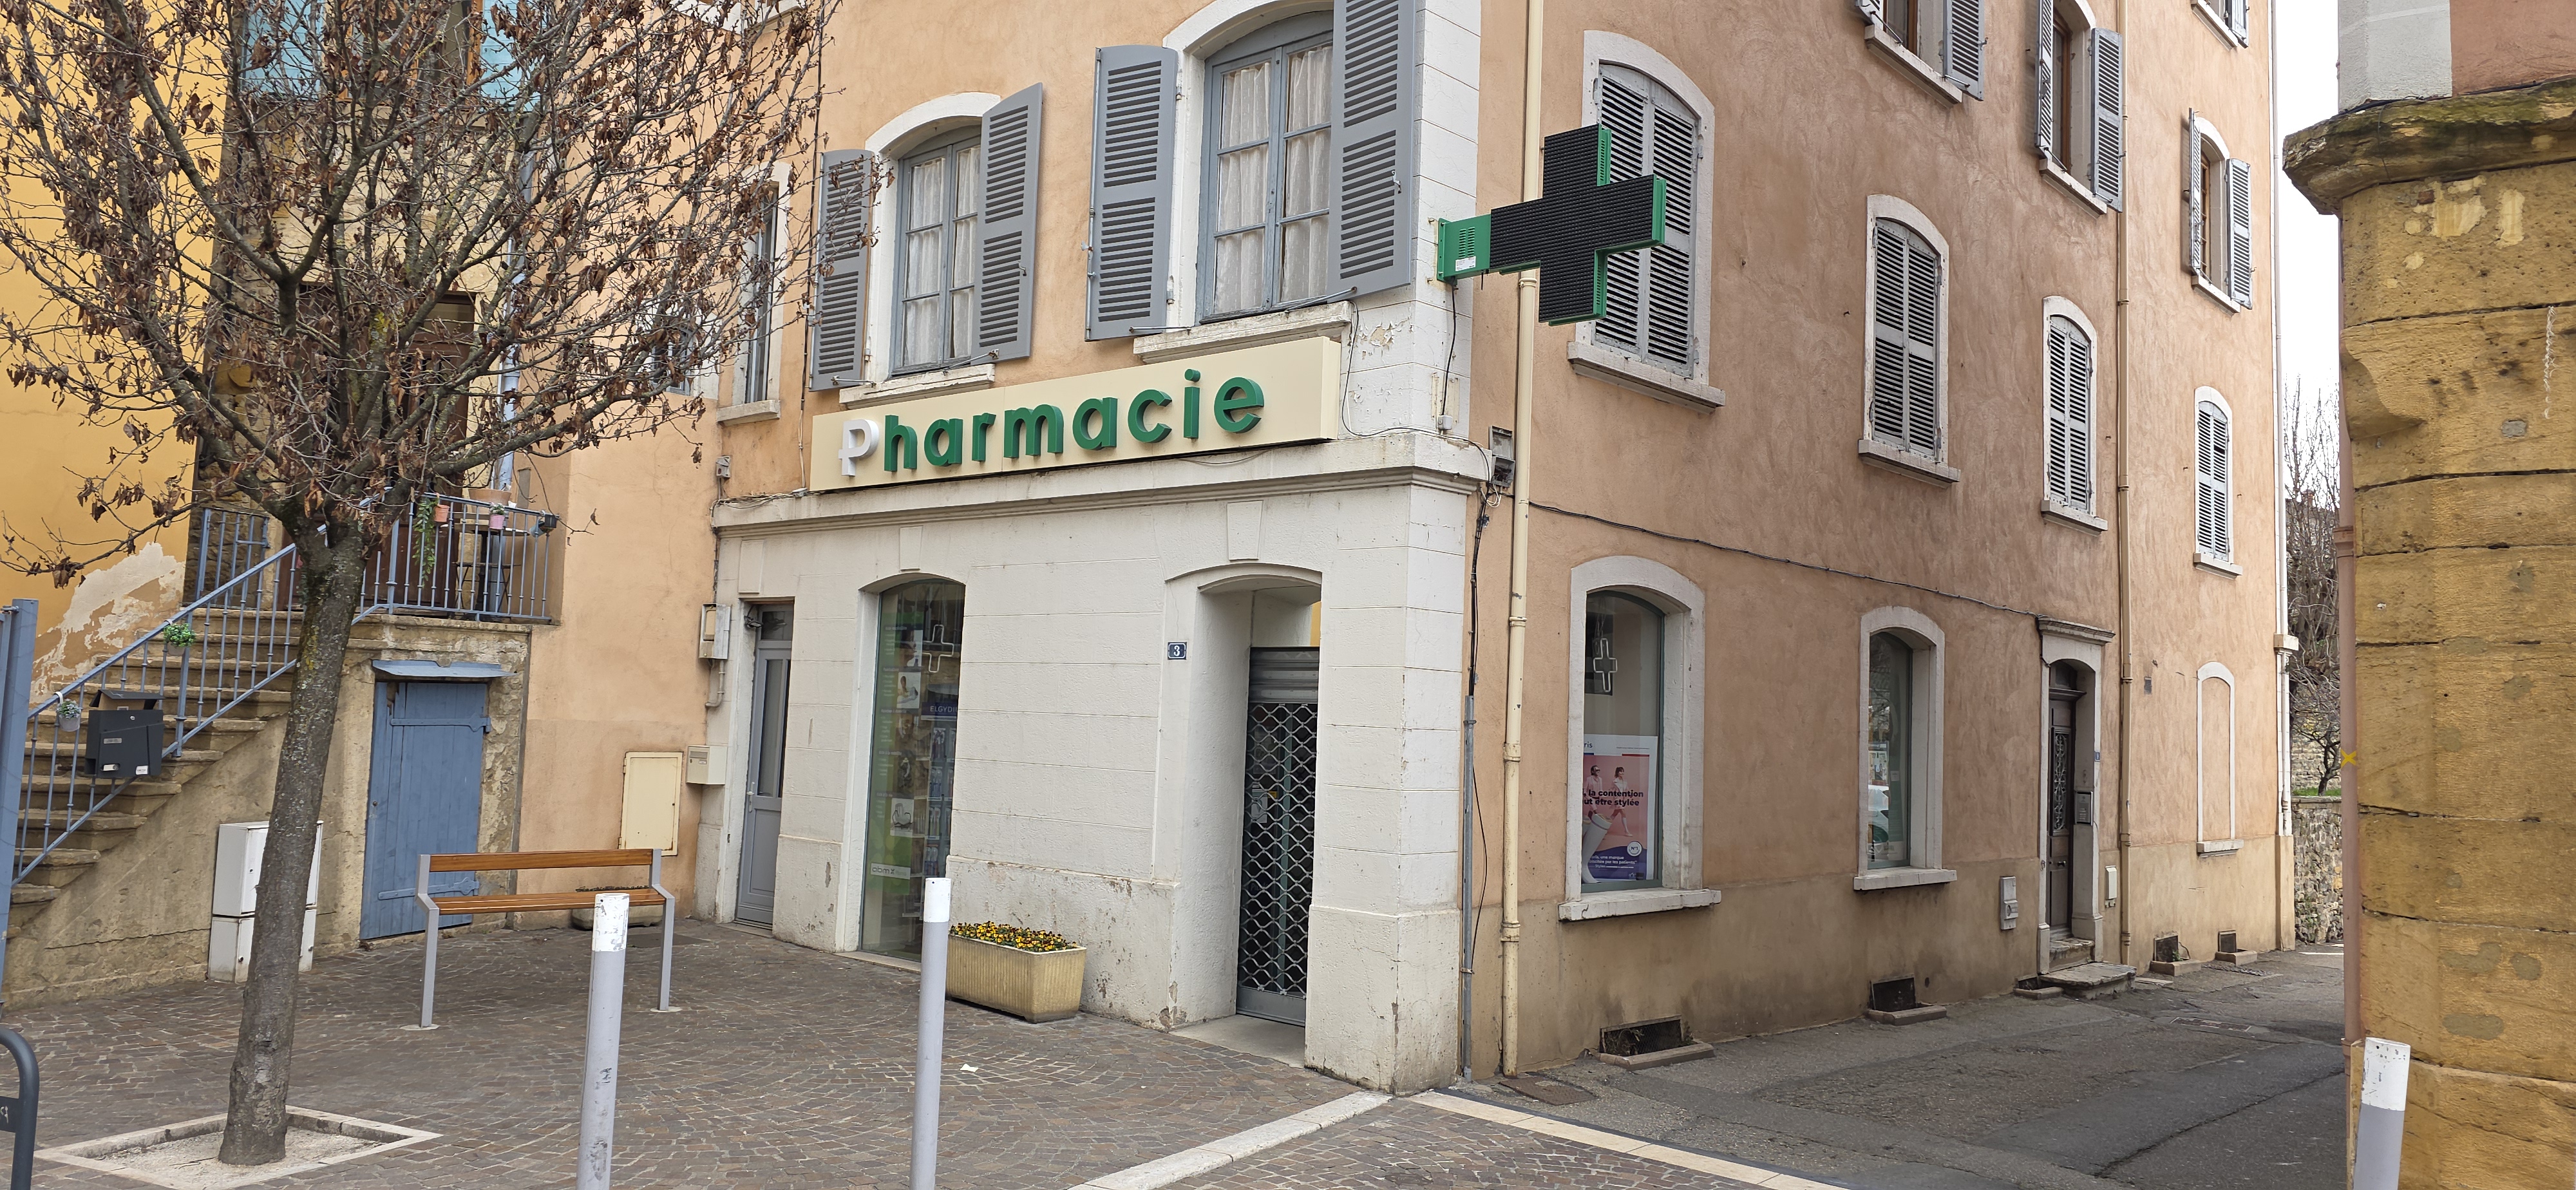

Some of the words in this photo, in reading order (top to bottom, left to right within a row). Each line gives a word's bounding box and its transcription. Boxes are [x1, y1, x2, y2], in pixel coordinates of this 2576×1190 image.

[838, 368, 1265, 477] Pharmacie
[1173, 645, 1180, 657] 3
[1614, 798, 1640, 807] stylée
